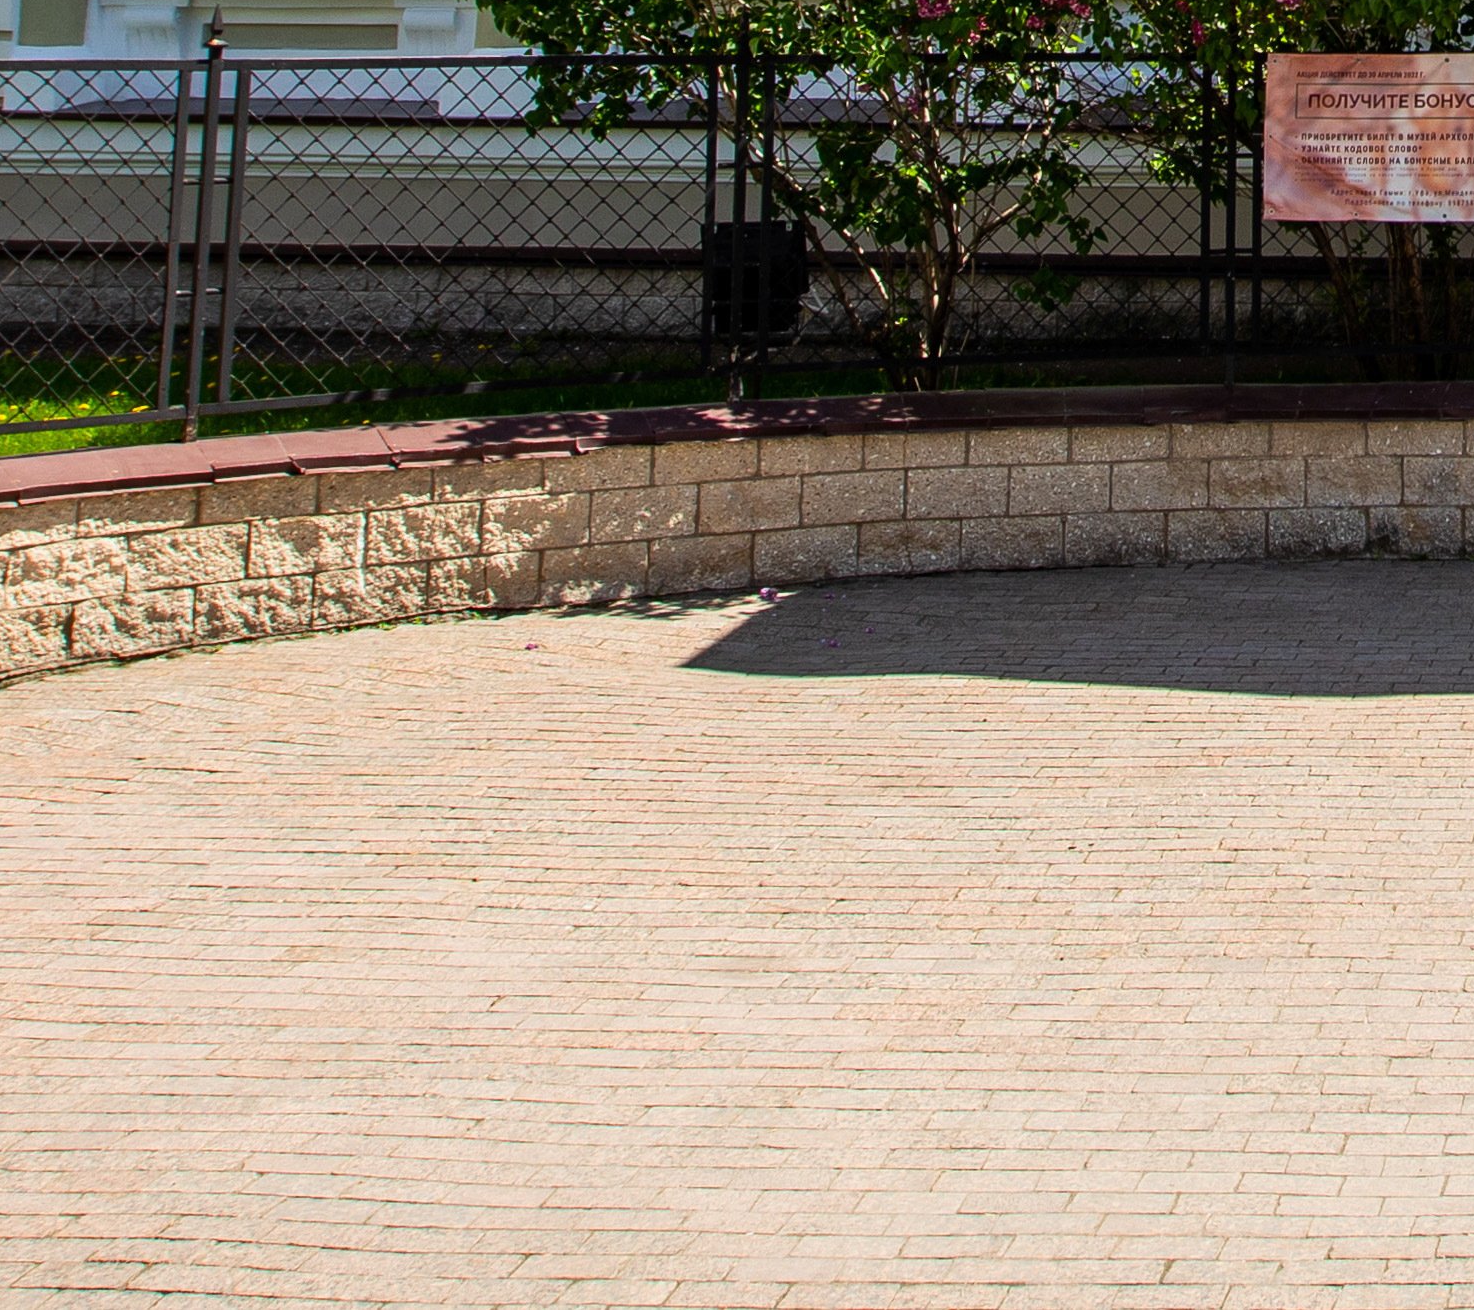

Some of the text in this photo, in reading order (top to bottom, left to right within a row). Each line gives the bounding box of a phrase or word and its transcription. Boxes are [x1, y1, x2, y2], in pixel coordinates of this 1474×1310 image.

[1308, 94, 1409, 109] ПОЛУЧИТЕ
[1301, 133, 1364, 141] ПРИОБРЕТИТЕ
[1367, 133, 1394, 141] БИЛЕТ
[1398, 133, 1403, 141] В
[1407, 133, 1436, 141] МУЗЕЙ
[1301, 145, 1341, 153] УЗНАЙТЕ
[1344, 145, 1385, 153] КОДОВОЕ
